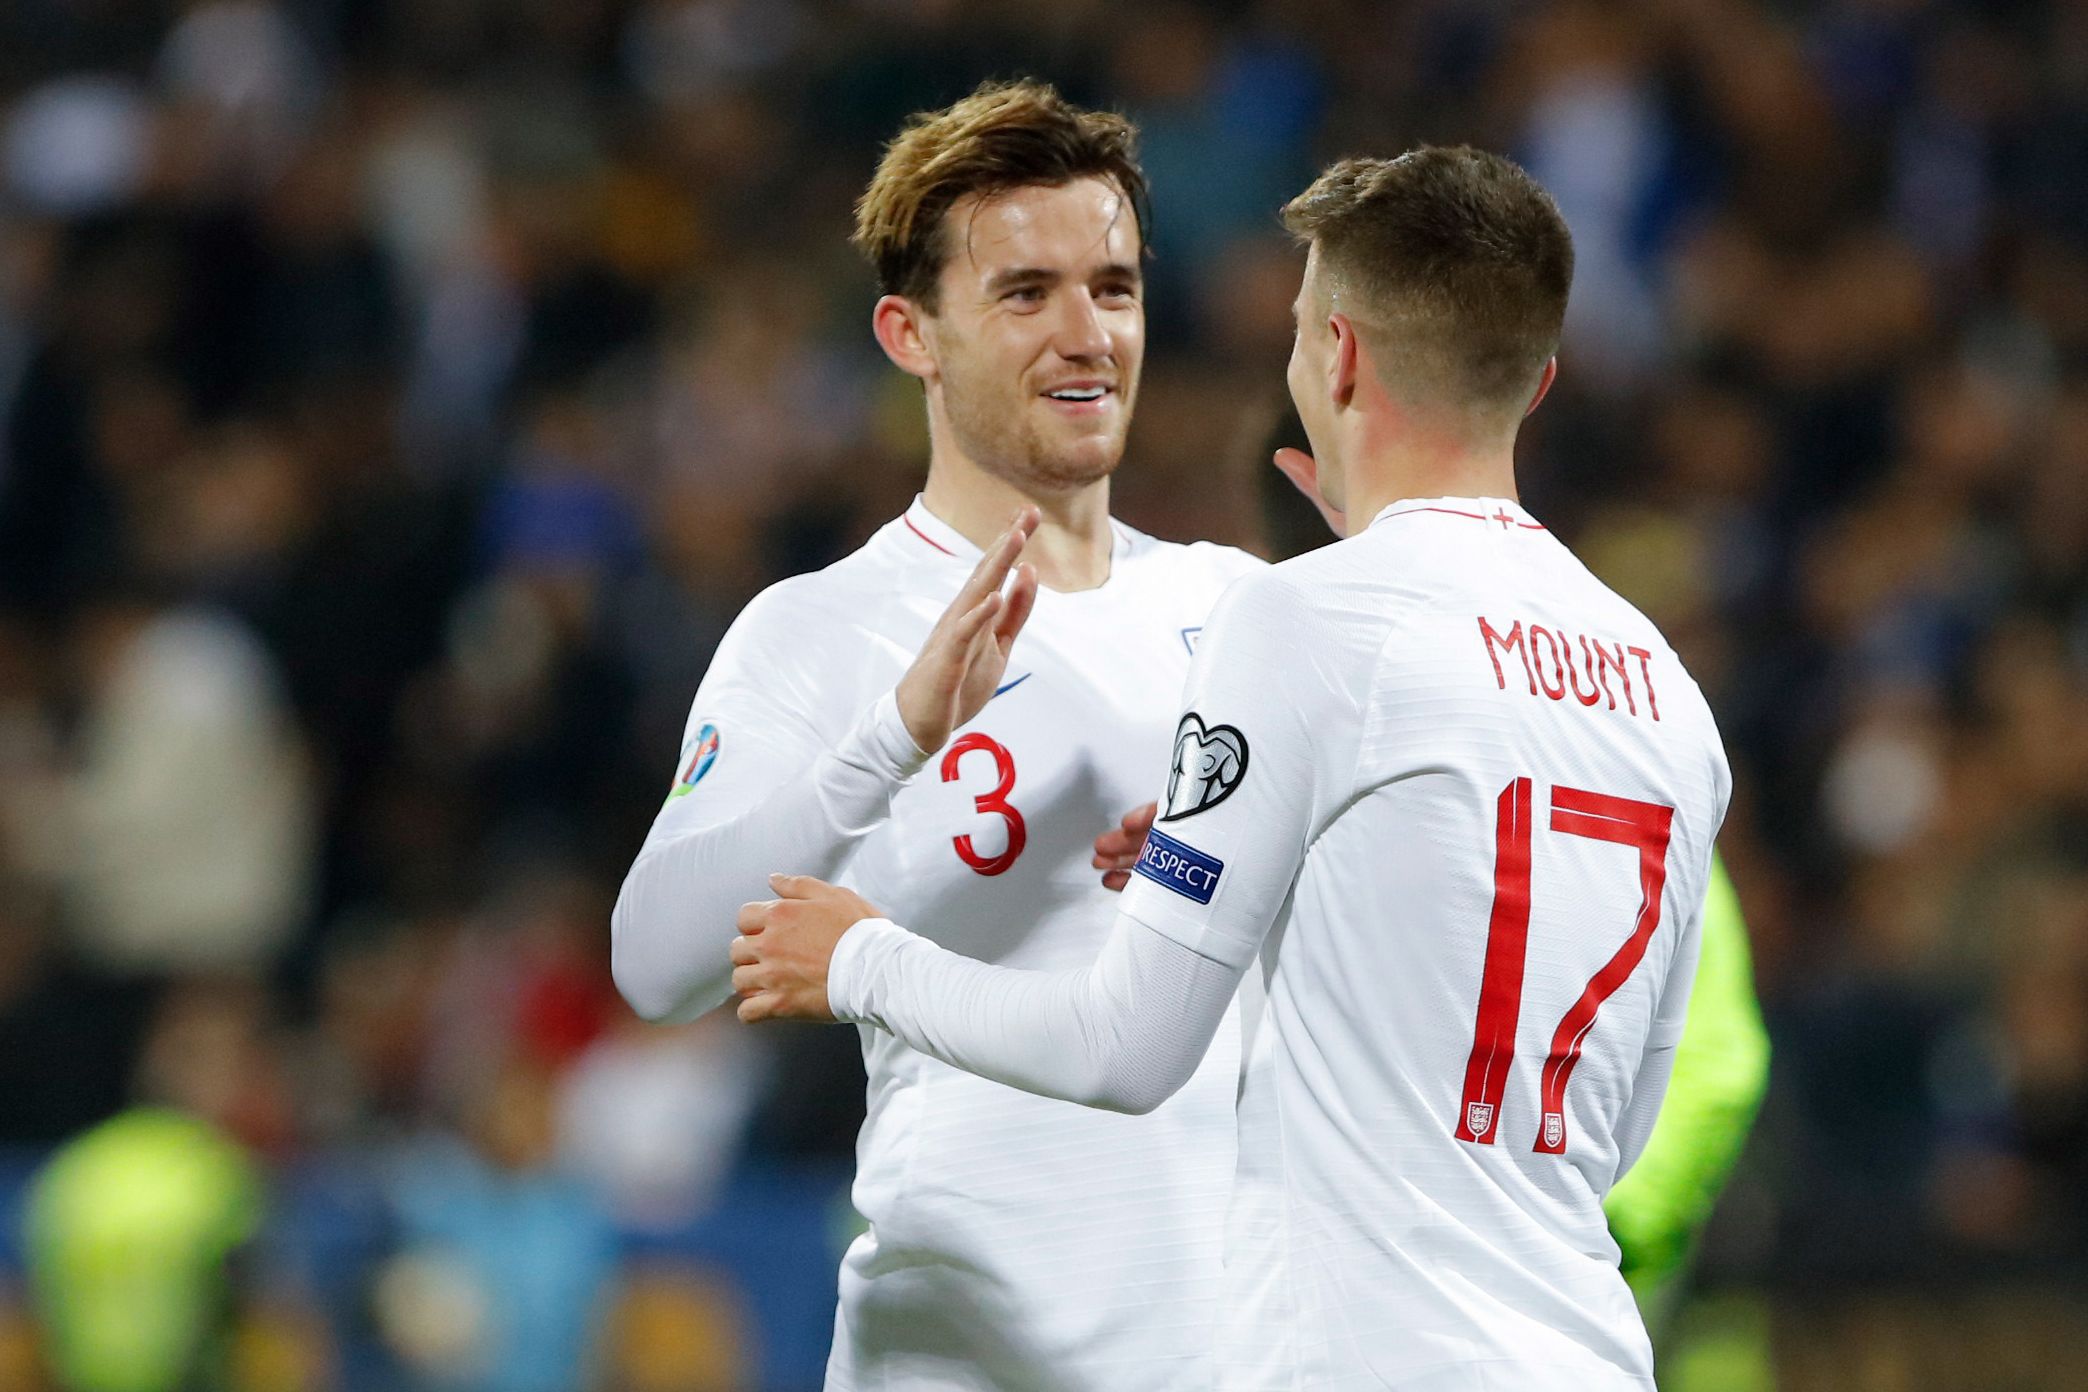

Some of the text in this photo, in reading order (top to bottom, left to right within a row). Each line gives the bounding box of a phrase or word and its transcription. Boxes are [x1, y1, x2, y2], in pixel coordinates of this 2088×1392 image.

[1477, 616, 1660, 721] MOUNT
[940, 732, 1027, 877] 3
[1141, 842, 1218, 891] RESPECT
[1454, 776, 1675, 1155] 17
